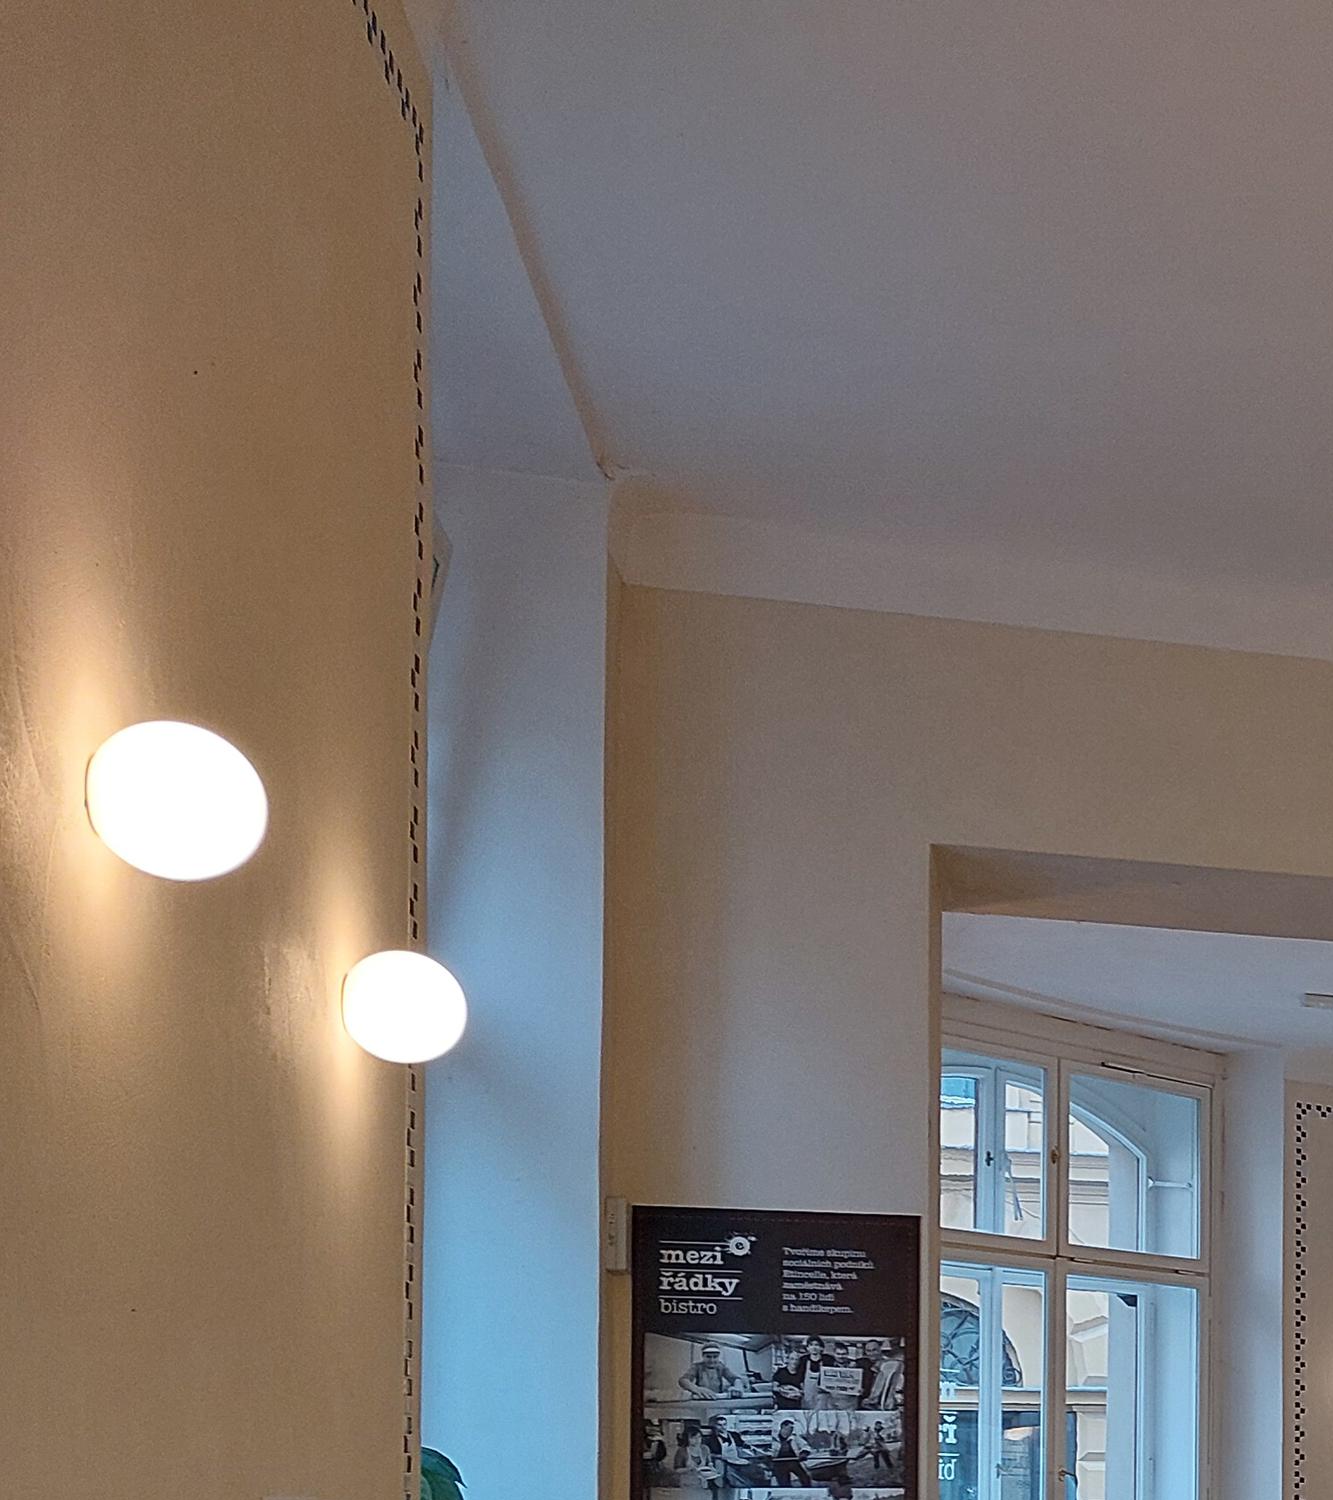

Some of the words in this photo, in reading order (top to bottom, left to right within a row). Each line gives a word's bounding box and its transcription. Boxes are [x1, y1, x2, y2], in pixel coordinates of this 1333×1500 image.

[659, 1246, 724, 1265] mezi
[659, 1272, 740, 1296] řádky
[660, 1299, 718, 1314] bistro
